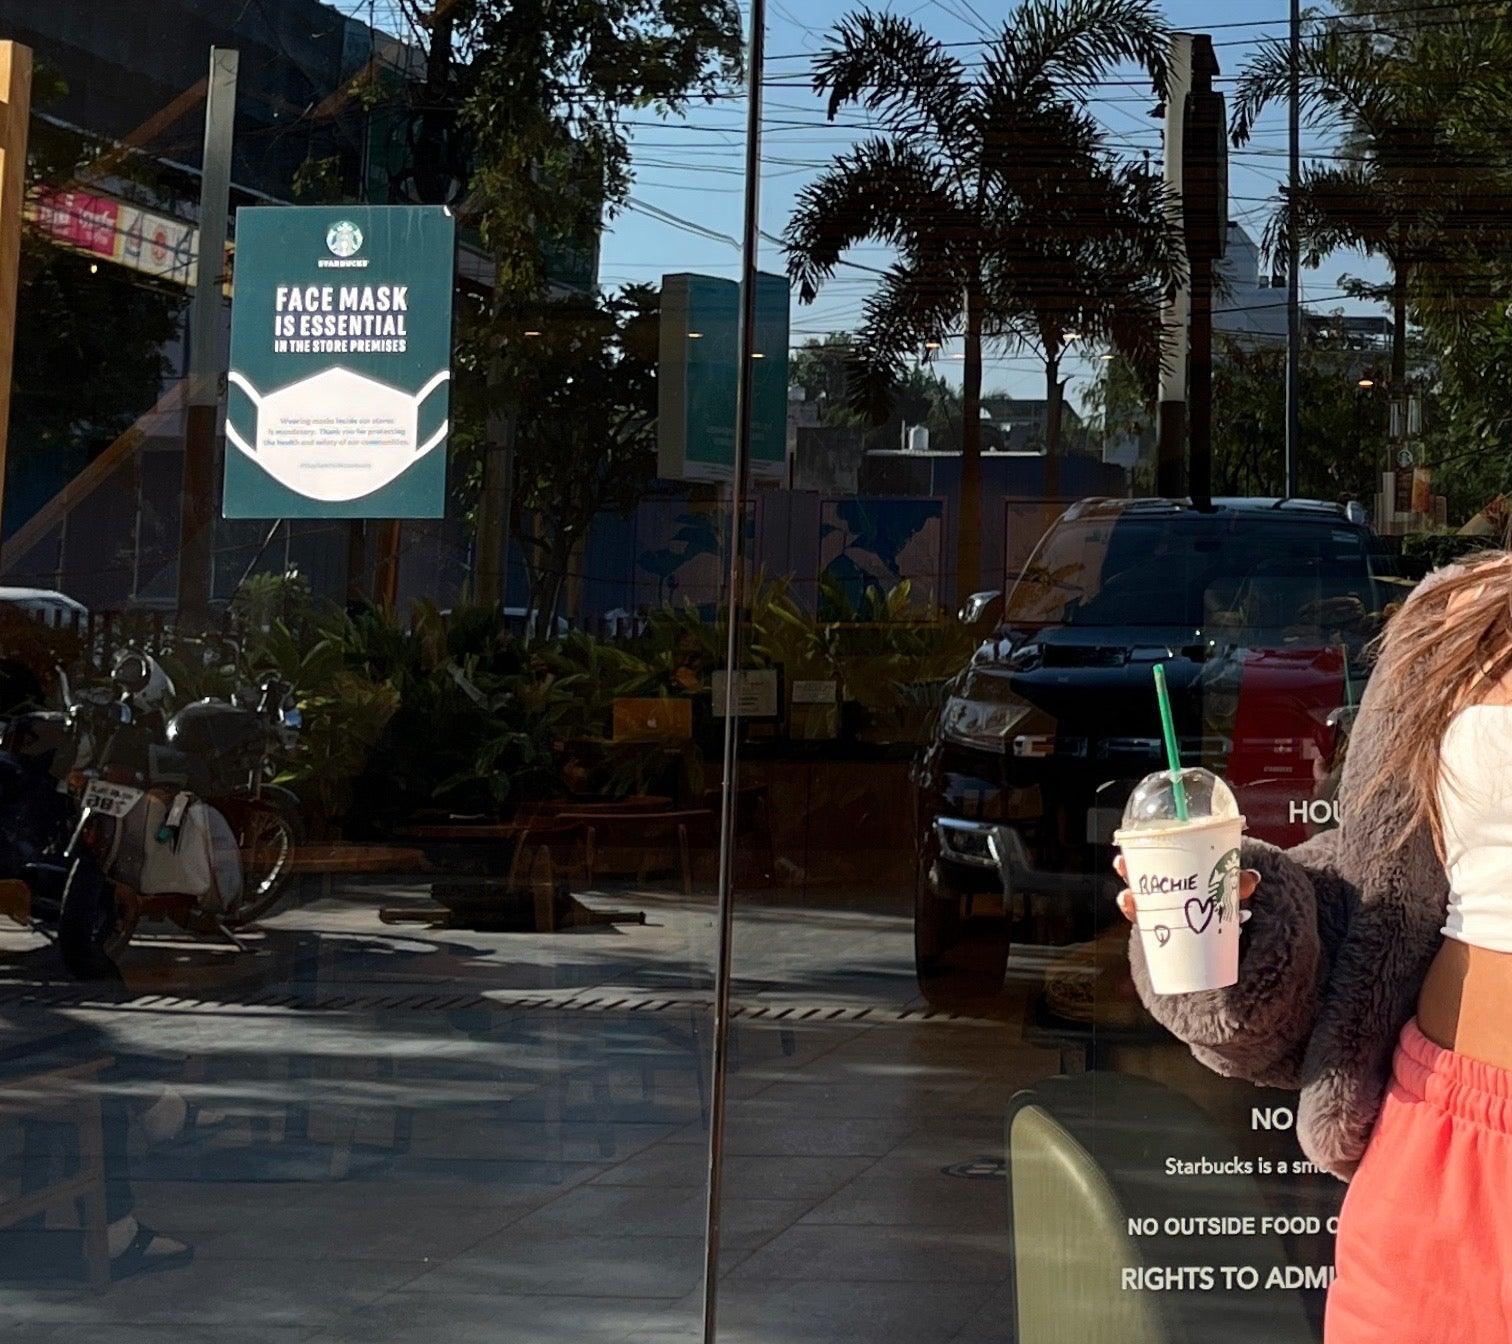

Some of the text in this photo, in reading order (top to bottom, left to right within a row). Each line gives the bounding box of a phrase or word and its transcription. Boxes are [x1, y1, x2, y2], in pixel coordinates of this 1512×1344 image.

[318, 259, 369, 268] STARBUCKS
[276, 286, 408, 312] FACE MASK
[274, 314, 407, 337] IS ESSENTIAL
[274, 339, 407, 353] IN THE STORE PREMISES
[1139, 873, 1198, 895] RACHIE
[1251, 1107, 1294, 1130] NO
[1165, 1156, 1328, 1175] Starbucks is a sm
[1127, 1216, 1339, 1236] NO OUTSIDE FOOD O
[1121, 1265, 1335, 1290] RIGHTS TO ADMI
